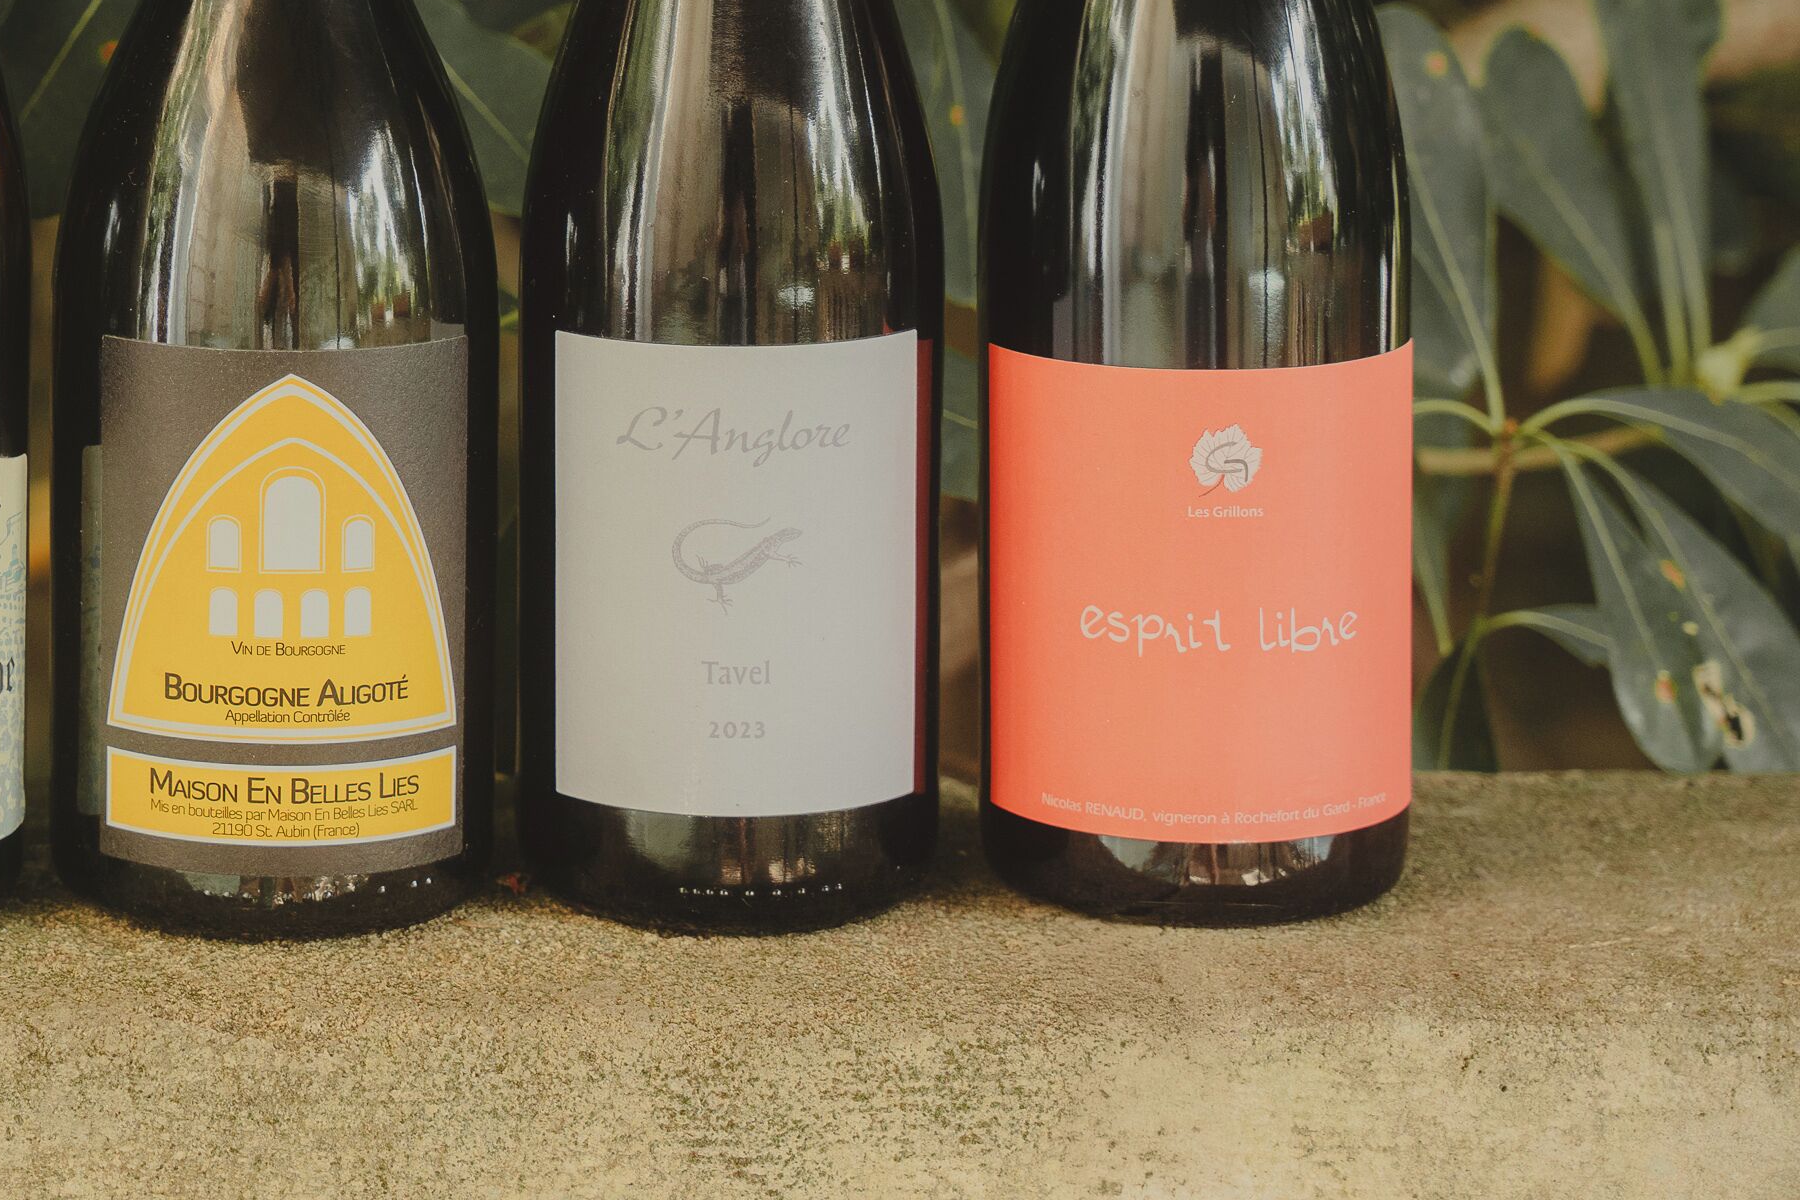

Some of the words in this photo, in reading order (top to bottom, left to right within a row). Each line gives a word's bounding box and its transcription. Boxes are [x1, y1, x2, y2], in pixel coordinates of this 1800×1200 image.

[616, 406, 851, 467] L'Anglore
[1188, 506, 1209, 518] Les
[1213, 505, 1264, 518] Grillons
[1080, 605, 1231, 657] esprit
[1258, 607, 1357, 653] libre
[701, 660, 771, 686] Tavel
[225, 709, 290, 725] Appellation
[293, 709, 350, 724] Contrôlée
[709, 721, 765, 739] 2023
[150, 798, 170, 813] Mis
[171, 804, 186, 816] en
[188, 802, 243, 820] bouteilles
[246, 810, 266, 824] par
[268, 808, 312, 822] Maison
[315, 808, 330, 821] En
[333, 805, 365, 820] Belles
[367, 802, 389, 818] Lies
[391, 798, 418, 813] SARL
[1041, 792, 1082, 812] Nicolas
[1153, 810, 1217, 826] vigneron
[1221, 812, 1230, 824] à
[1235, 809, 1300, 824] Rochefort
[1303, 807, 1319, 820] du
[1322, 801, 1350, 817] Gard
[1358, 792, 1387, 809] France
[212, 822, 253, 837] 21190
[256, 824, 273, 838] St.
[276, 824, 311, 839] Aubin
[313, 822, 360, 840] (France)
